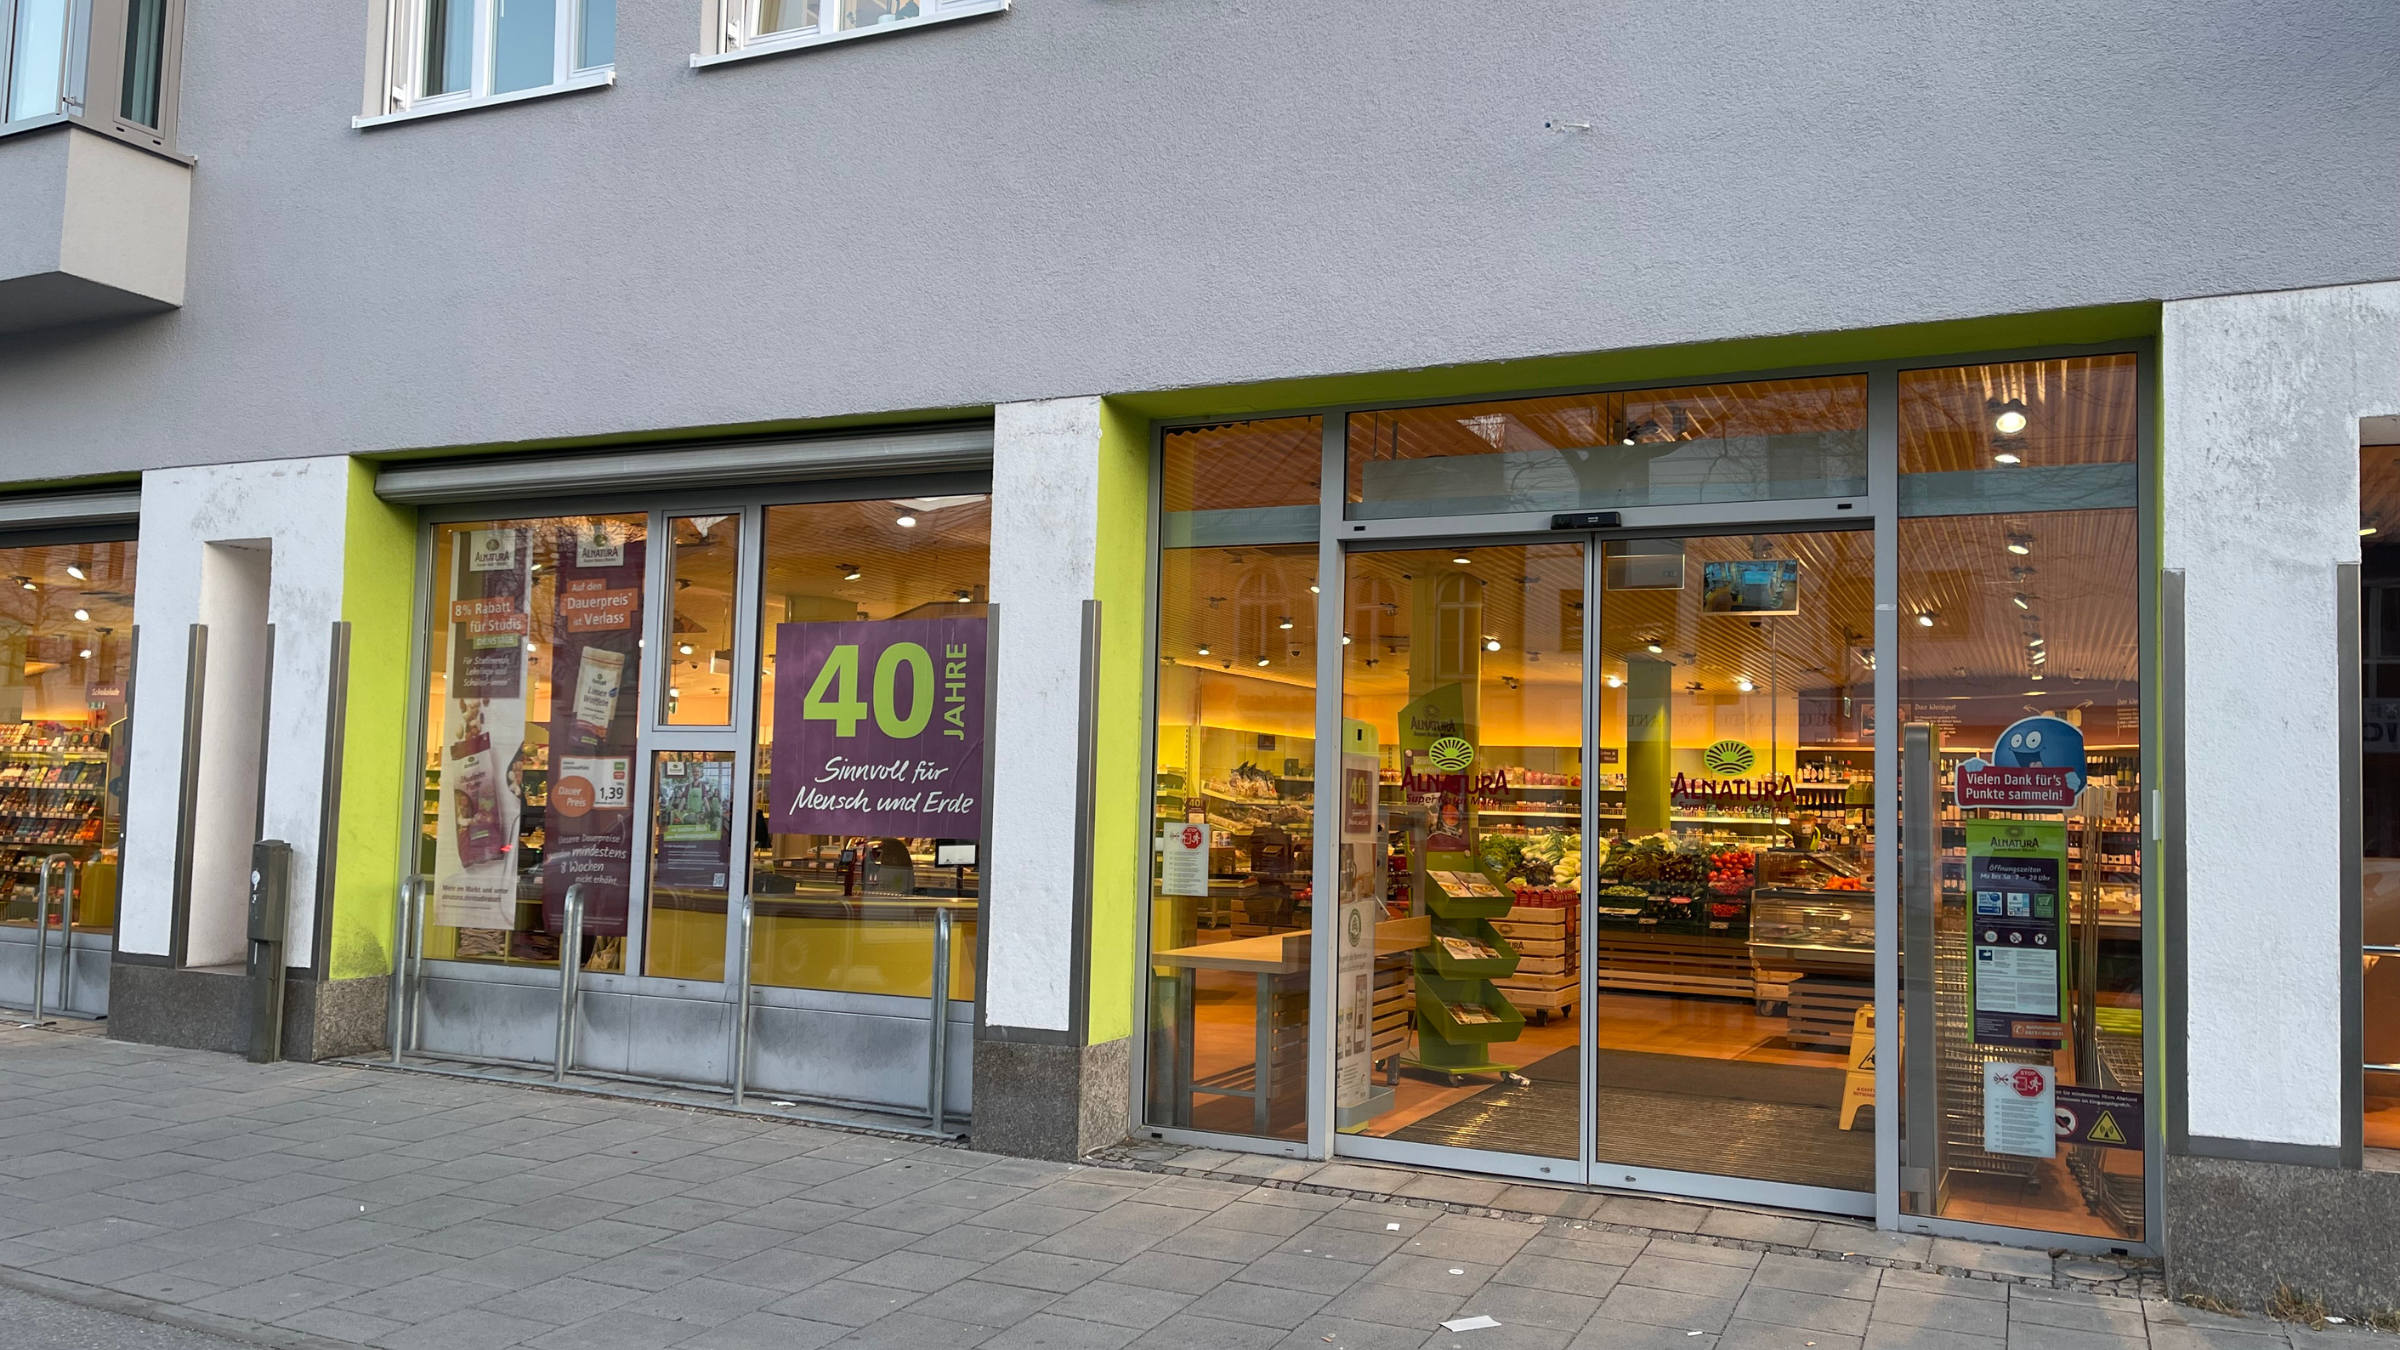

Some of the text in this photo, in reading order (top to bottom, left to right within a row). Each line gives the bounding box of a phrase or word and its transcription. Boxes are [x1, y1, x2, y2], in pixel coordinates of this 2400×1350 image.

[474, 550, 510, 562] ALNATURA
[582, 545, 619, 558] ALNATURA
[571, 581, 602, 592] Auf den
[455, 601, 511, 617] 8% Rabatt
[470, 617, 522, 632] für Studis
[573, 611, 624, 626] ist Verlass
[803, 642, 935, 739] 40
[943, 643, 967, 740] JAHRE
[1929, 703, 1957, 713] Weingut
[1411, 716, 1455, 732] ALNATURA
[814, 755, 949, 784] Sinnvoll für
[1401, 767, 1509, 795] ALNATURA
[1966, 773, 2062, 786] Vielen Dank für's
[558, 786, 582, 796] Dauer
[600, 786, 624, 801] 1,39
[1350, 776, 1366, 805] 40
[1671, 771, 1797, 803] ALNATURA
[789, 785, 974, 816] Mensch und Erde
[1406, 793, 1436, 804] Super
[1470, 796, 1503, 806] Markt
[1966, 788, 2063, 801] Punkte sammeln!
[566, 797, 587, 807] Preis
[1677, 801, 1711, 812] Super
[1752, 803, 1789, 815] Markt
[558, 833, 621, 845] Unsere Dauerpreise
[1990, 836, 2040, 848] ALNATURA
[572, 844, 627, 860] mindestens
[560, 859, 605, 874] 8 Wochen
[1988, 864, 2042, 875] Öffnungszeiten
[575, 874, 592, 883] nicht
[1980, 872, 1990, 880] Mo
[1991, 872, 2001, 880] bis
